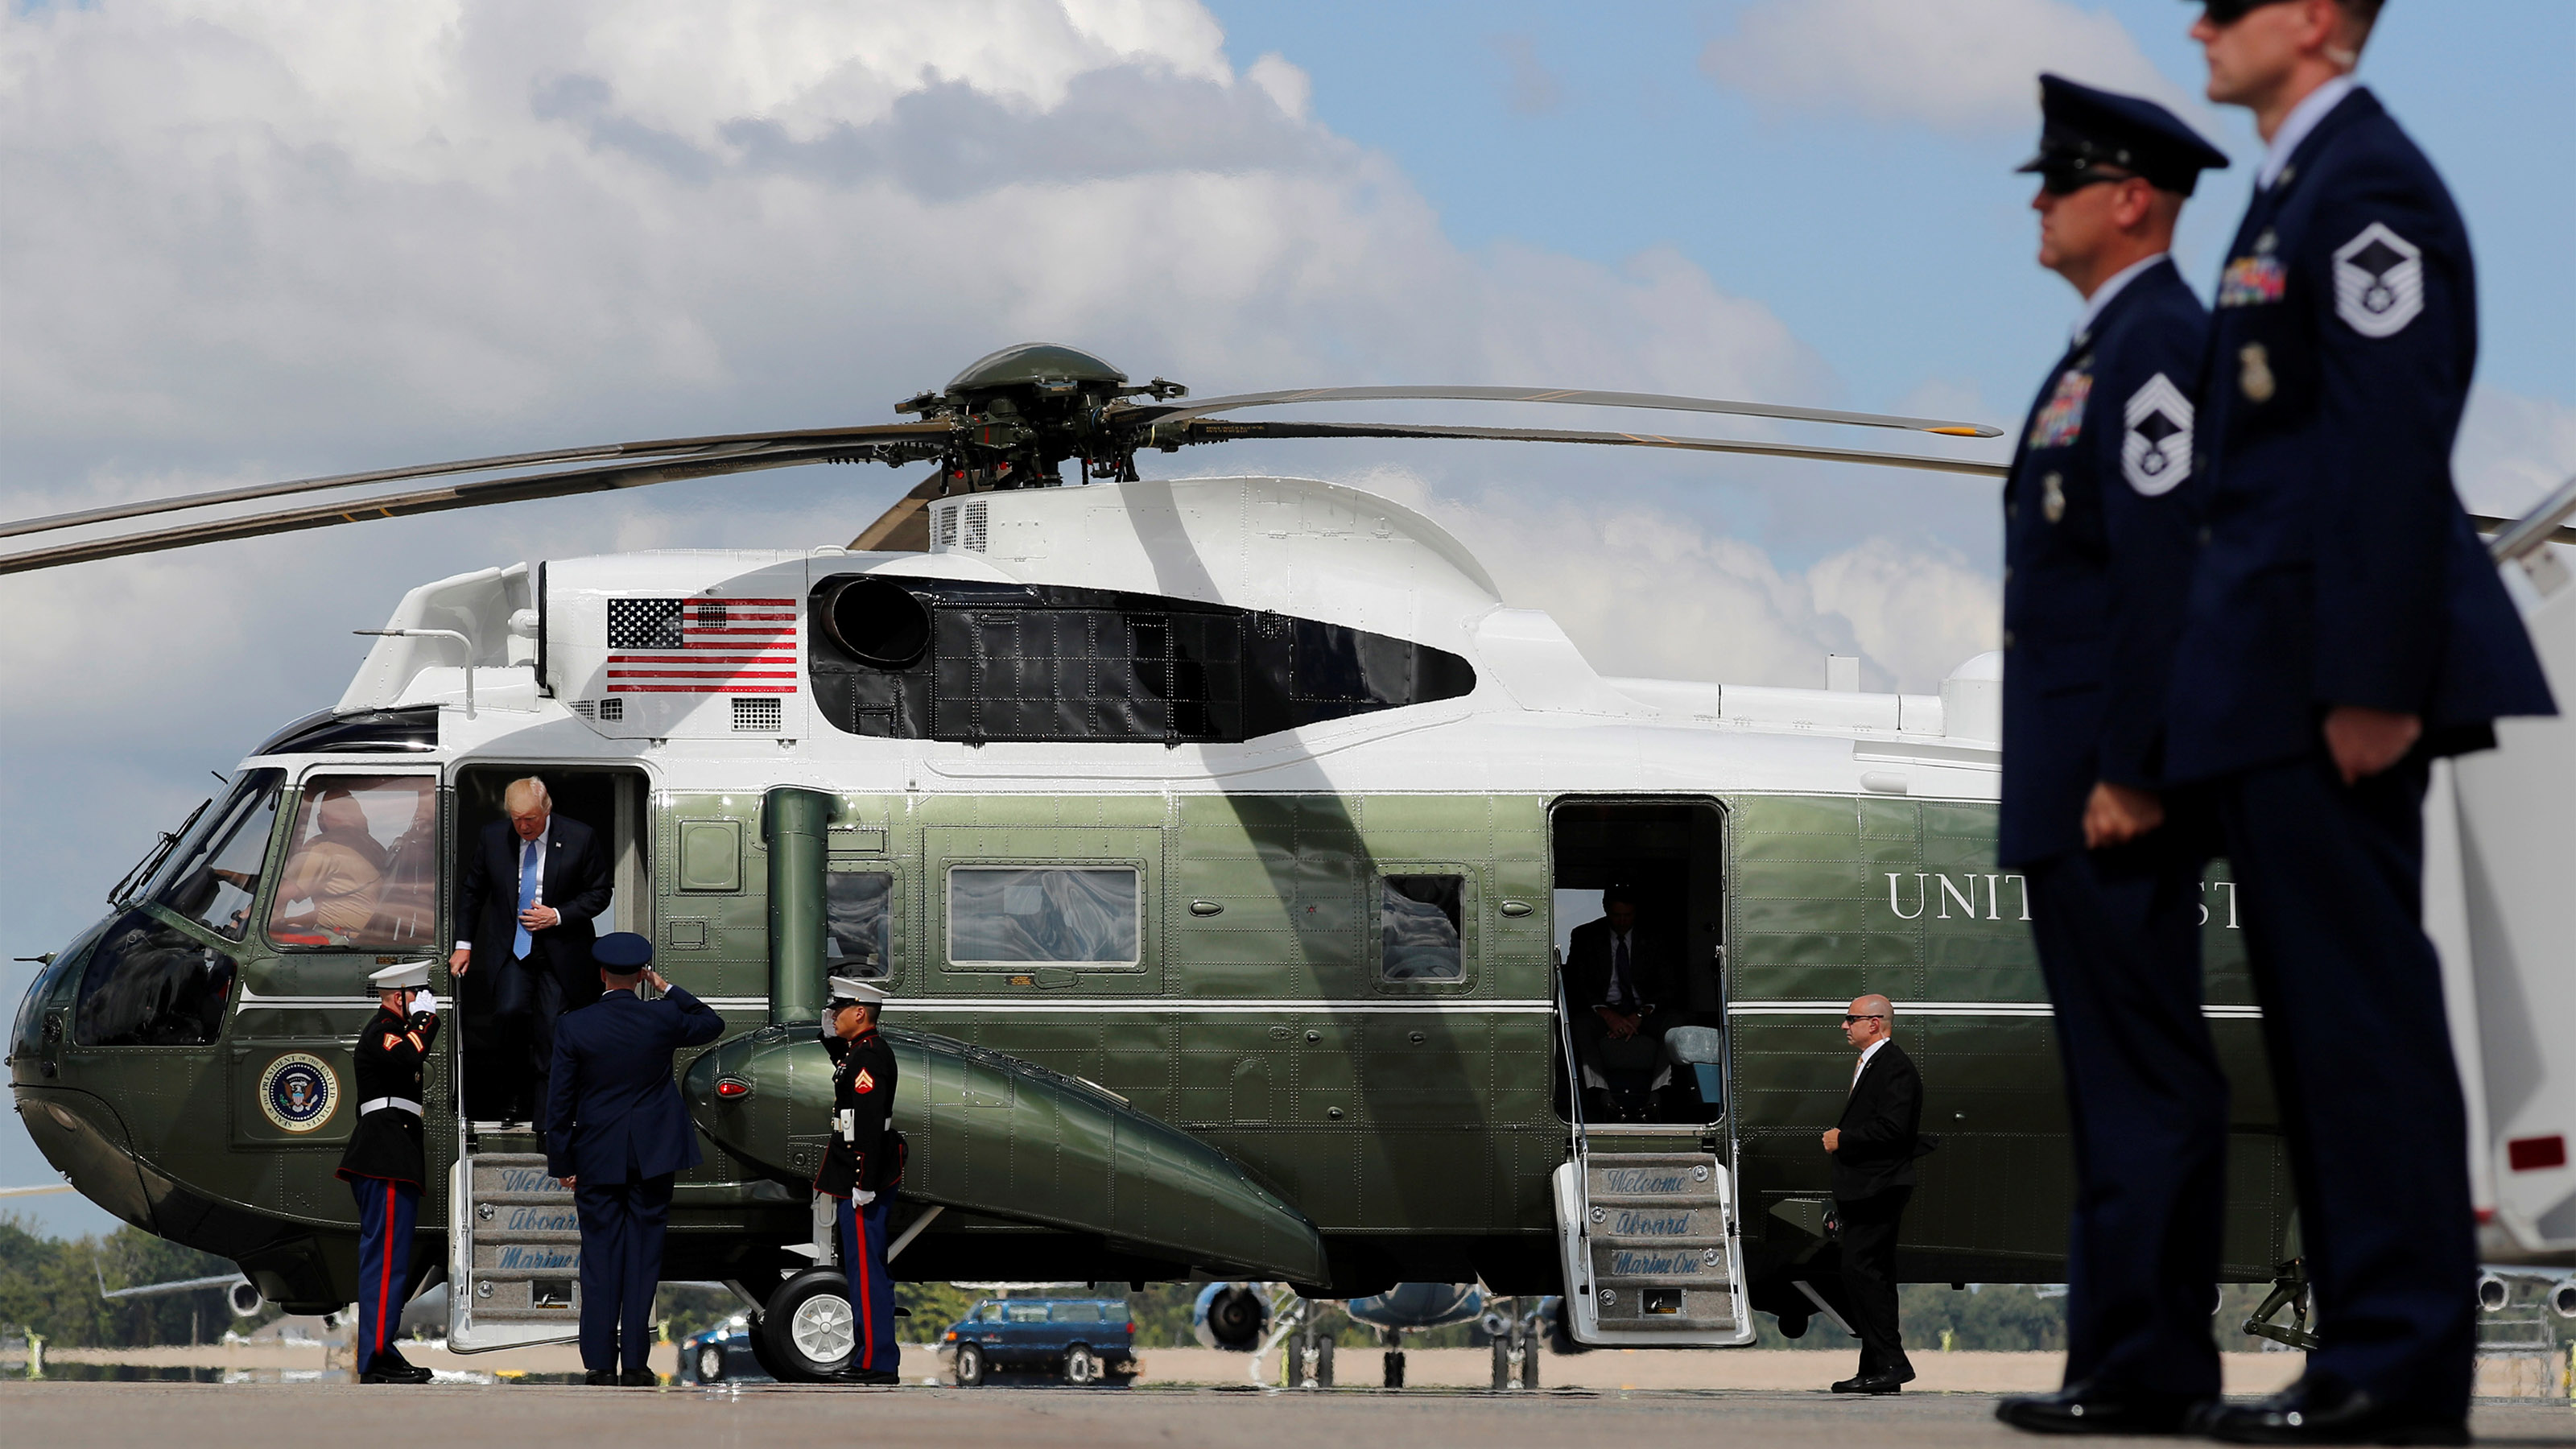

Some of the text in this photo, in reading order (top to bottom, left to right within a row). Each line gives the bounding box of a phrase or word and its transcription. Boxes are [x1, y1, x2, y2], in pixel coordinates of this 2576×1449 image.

[1884, 873, 2033, 921] UNIT
[308, 1057, 319, 1065] THE
[262, 1055, 297, 1092] PRESIDENT
[320, 1065, 336, 1098] UNITED
[274, 1115, 292, 1127] SEAL
[306, 1104, 332, 1128] STATES
[1608, 1170, 1686, 1192] Welcome
[508, 1208, 580, 1231] Aboar
[1616, 1212, 1689, 1234] Aboard
[500, 1246, 572, 1269] Marine
[1615, 1252, 1699, 1274] Marine One
